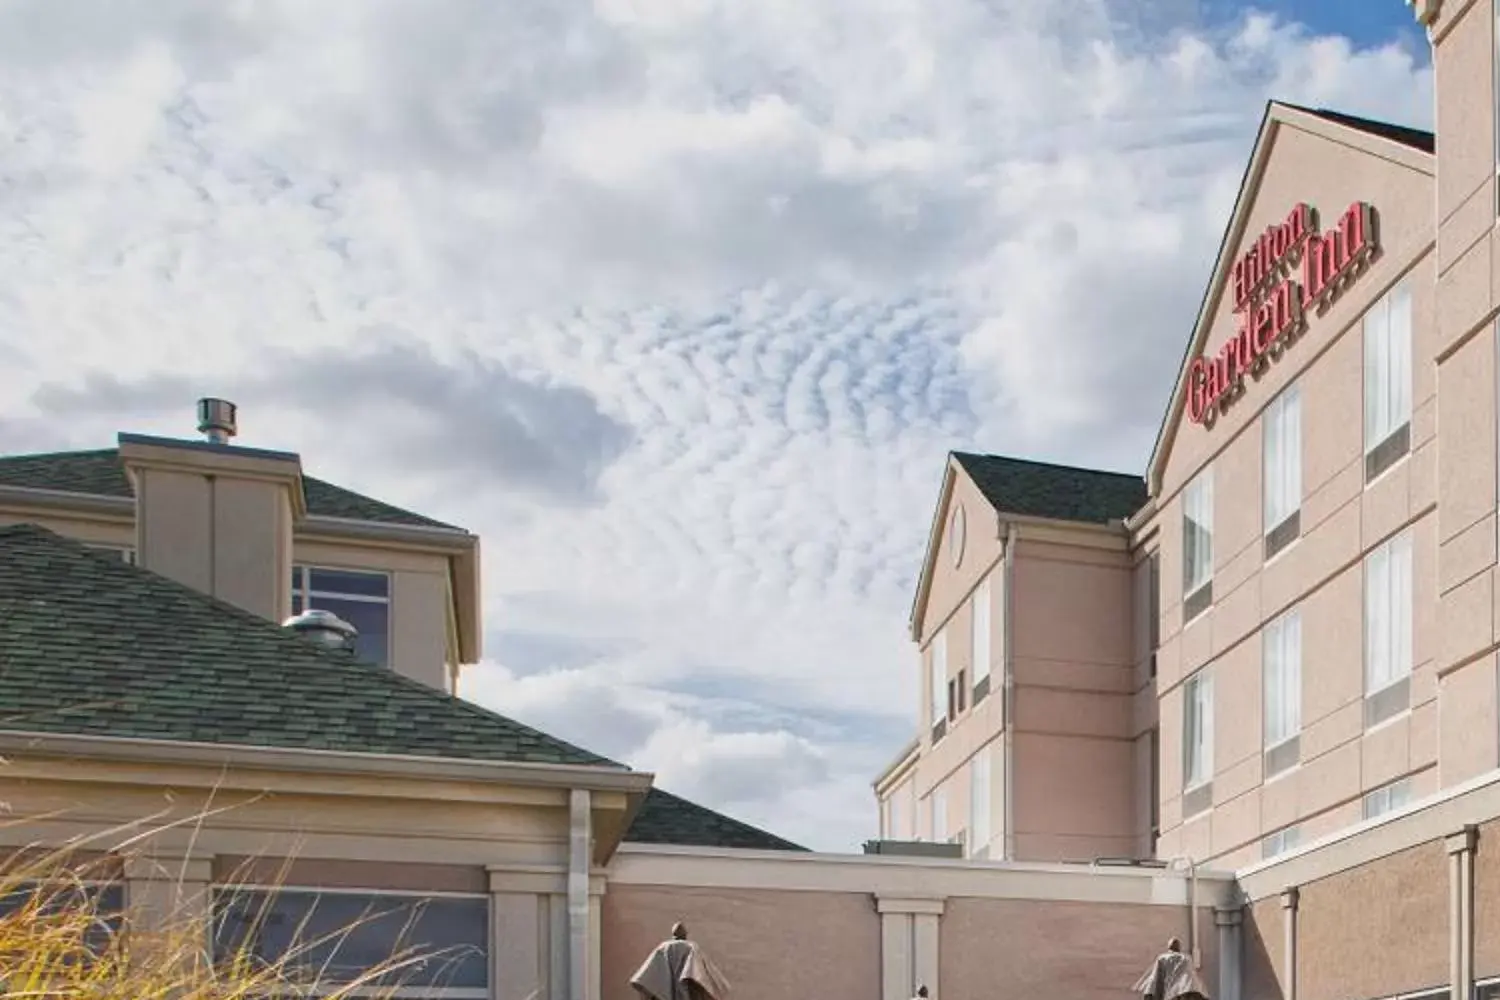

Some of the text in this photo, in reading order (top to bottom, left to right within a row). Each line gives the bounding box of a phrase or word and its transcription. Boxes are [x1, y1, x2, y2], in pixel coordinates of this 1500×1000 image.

[1187, 200, 1370, 424] Garden Inn
[1232, 202, 1311, 313] Hilton
